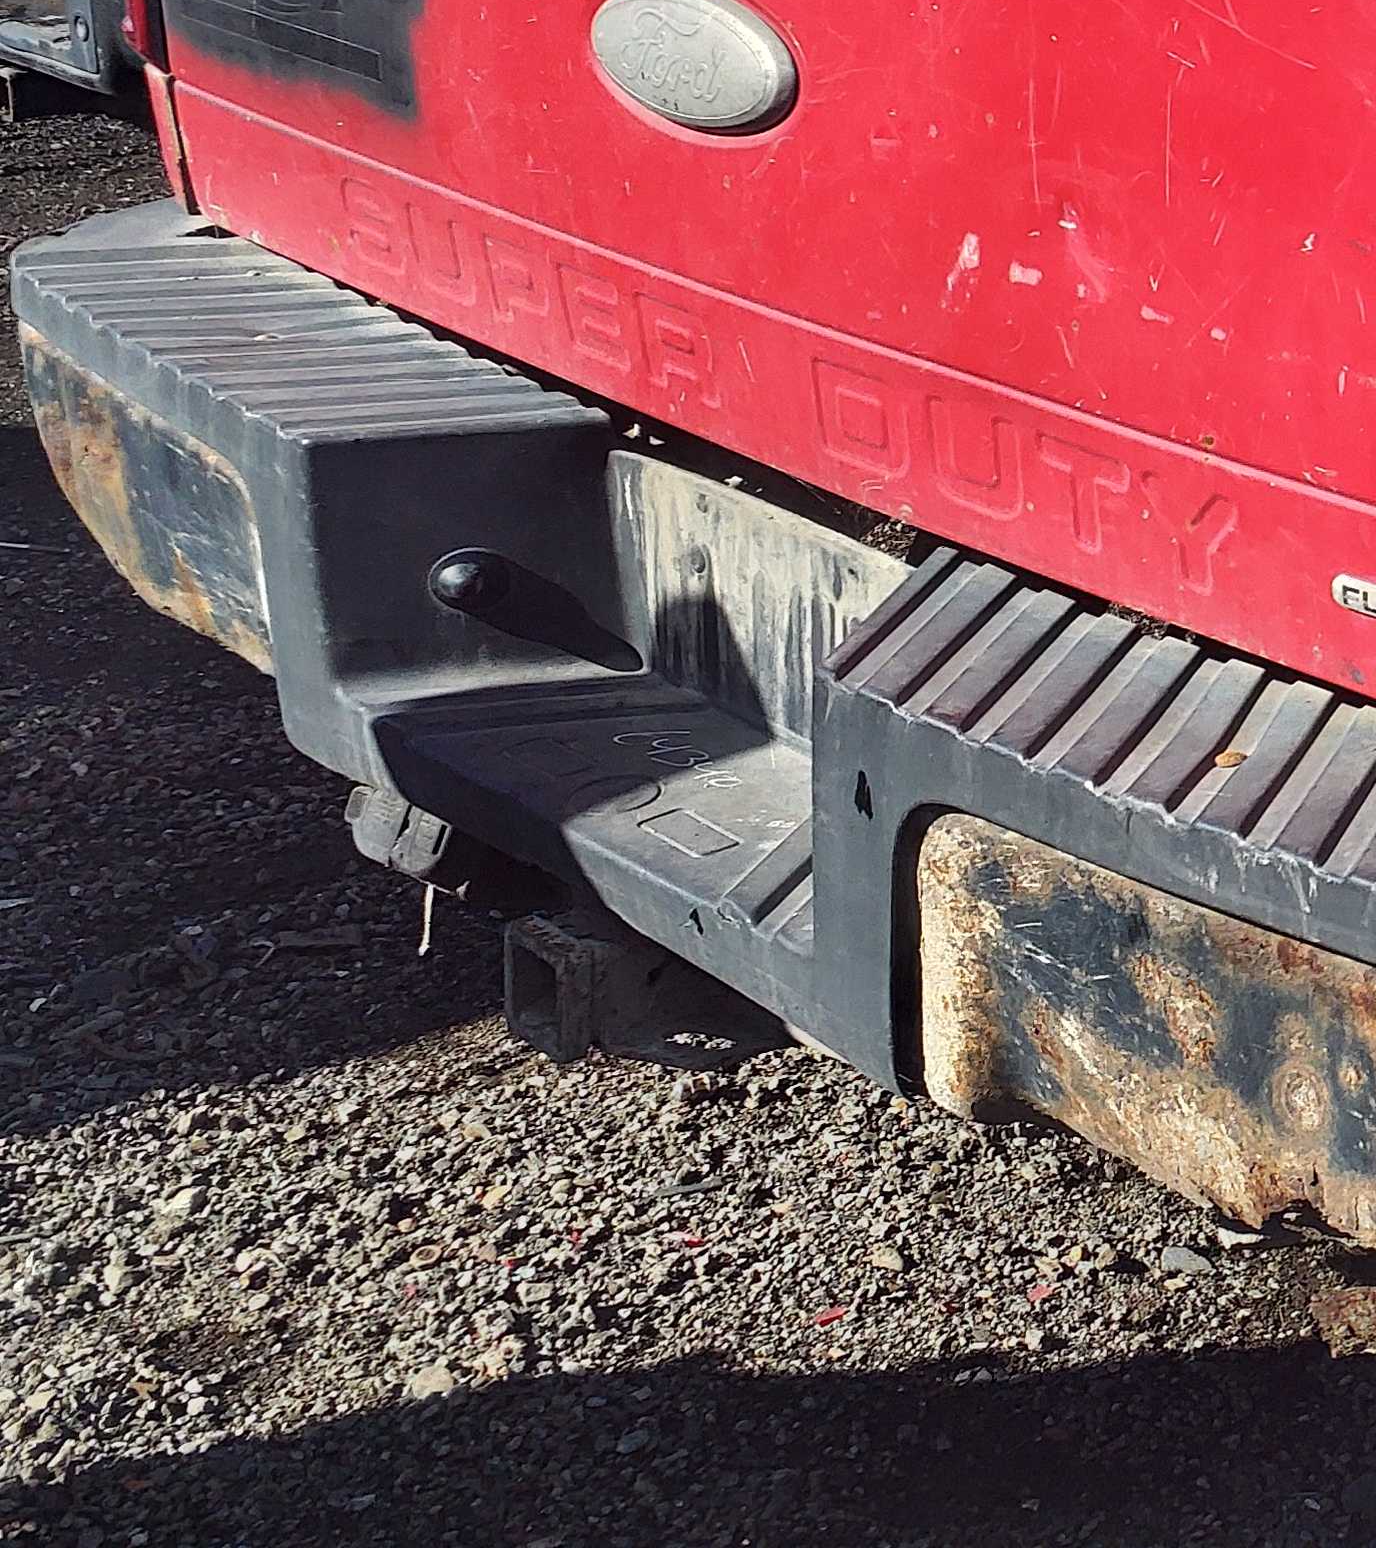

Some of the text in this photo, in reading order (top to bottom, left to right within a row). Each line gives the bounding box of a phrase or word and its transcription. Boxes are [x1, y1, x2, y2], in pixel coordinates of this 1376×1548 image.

[618, 7, 727, 103] Ford
[340, 176, 1239, 596] SUPER DUTY
